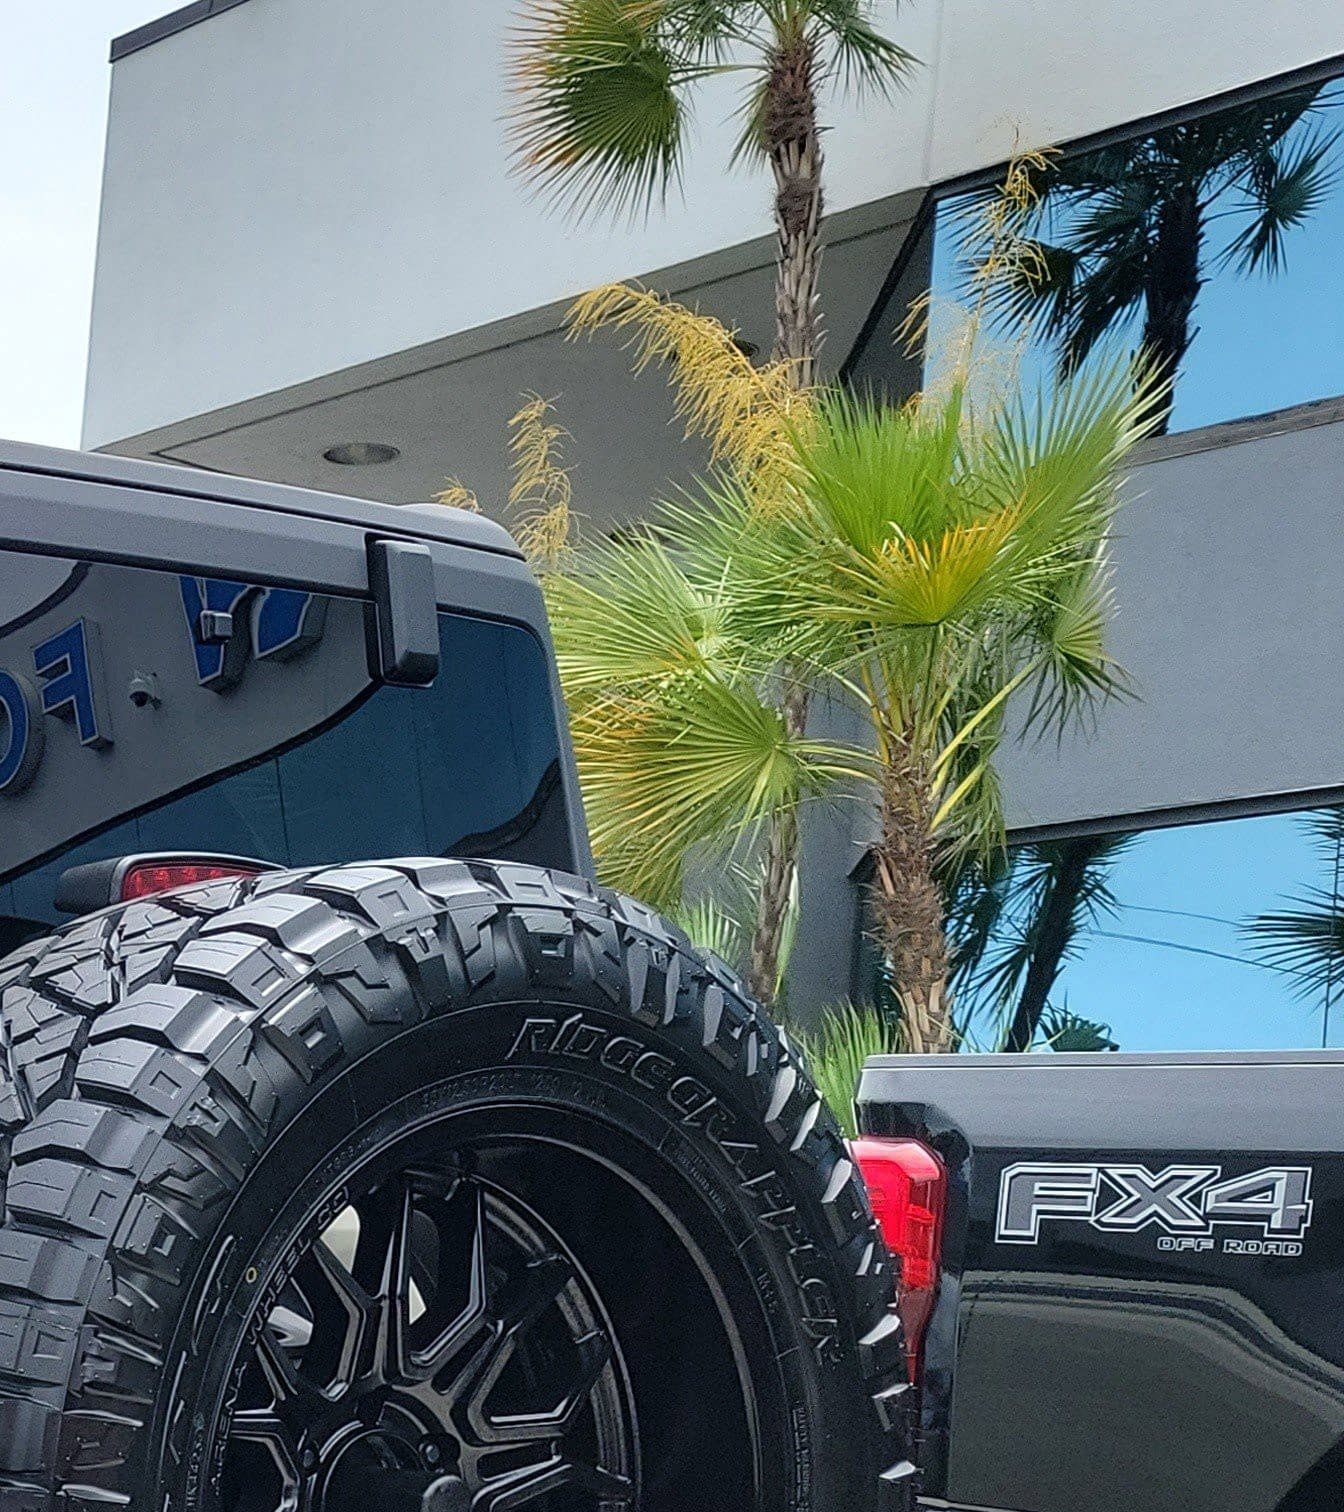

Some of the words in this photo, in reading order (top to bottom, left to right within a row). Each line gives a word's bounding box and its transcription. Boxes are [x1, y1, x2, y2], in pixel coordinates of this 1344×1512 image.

[504, 1012, 676, 1090] RIDGE
[995, 1162, 1312, 1245] FX4
[1157, 1236, 1214, 1252] OFF
[1222, 1239, 1303, 1257] ROAD
